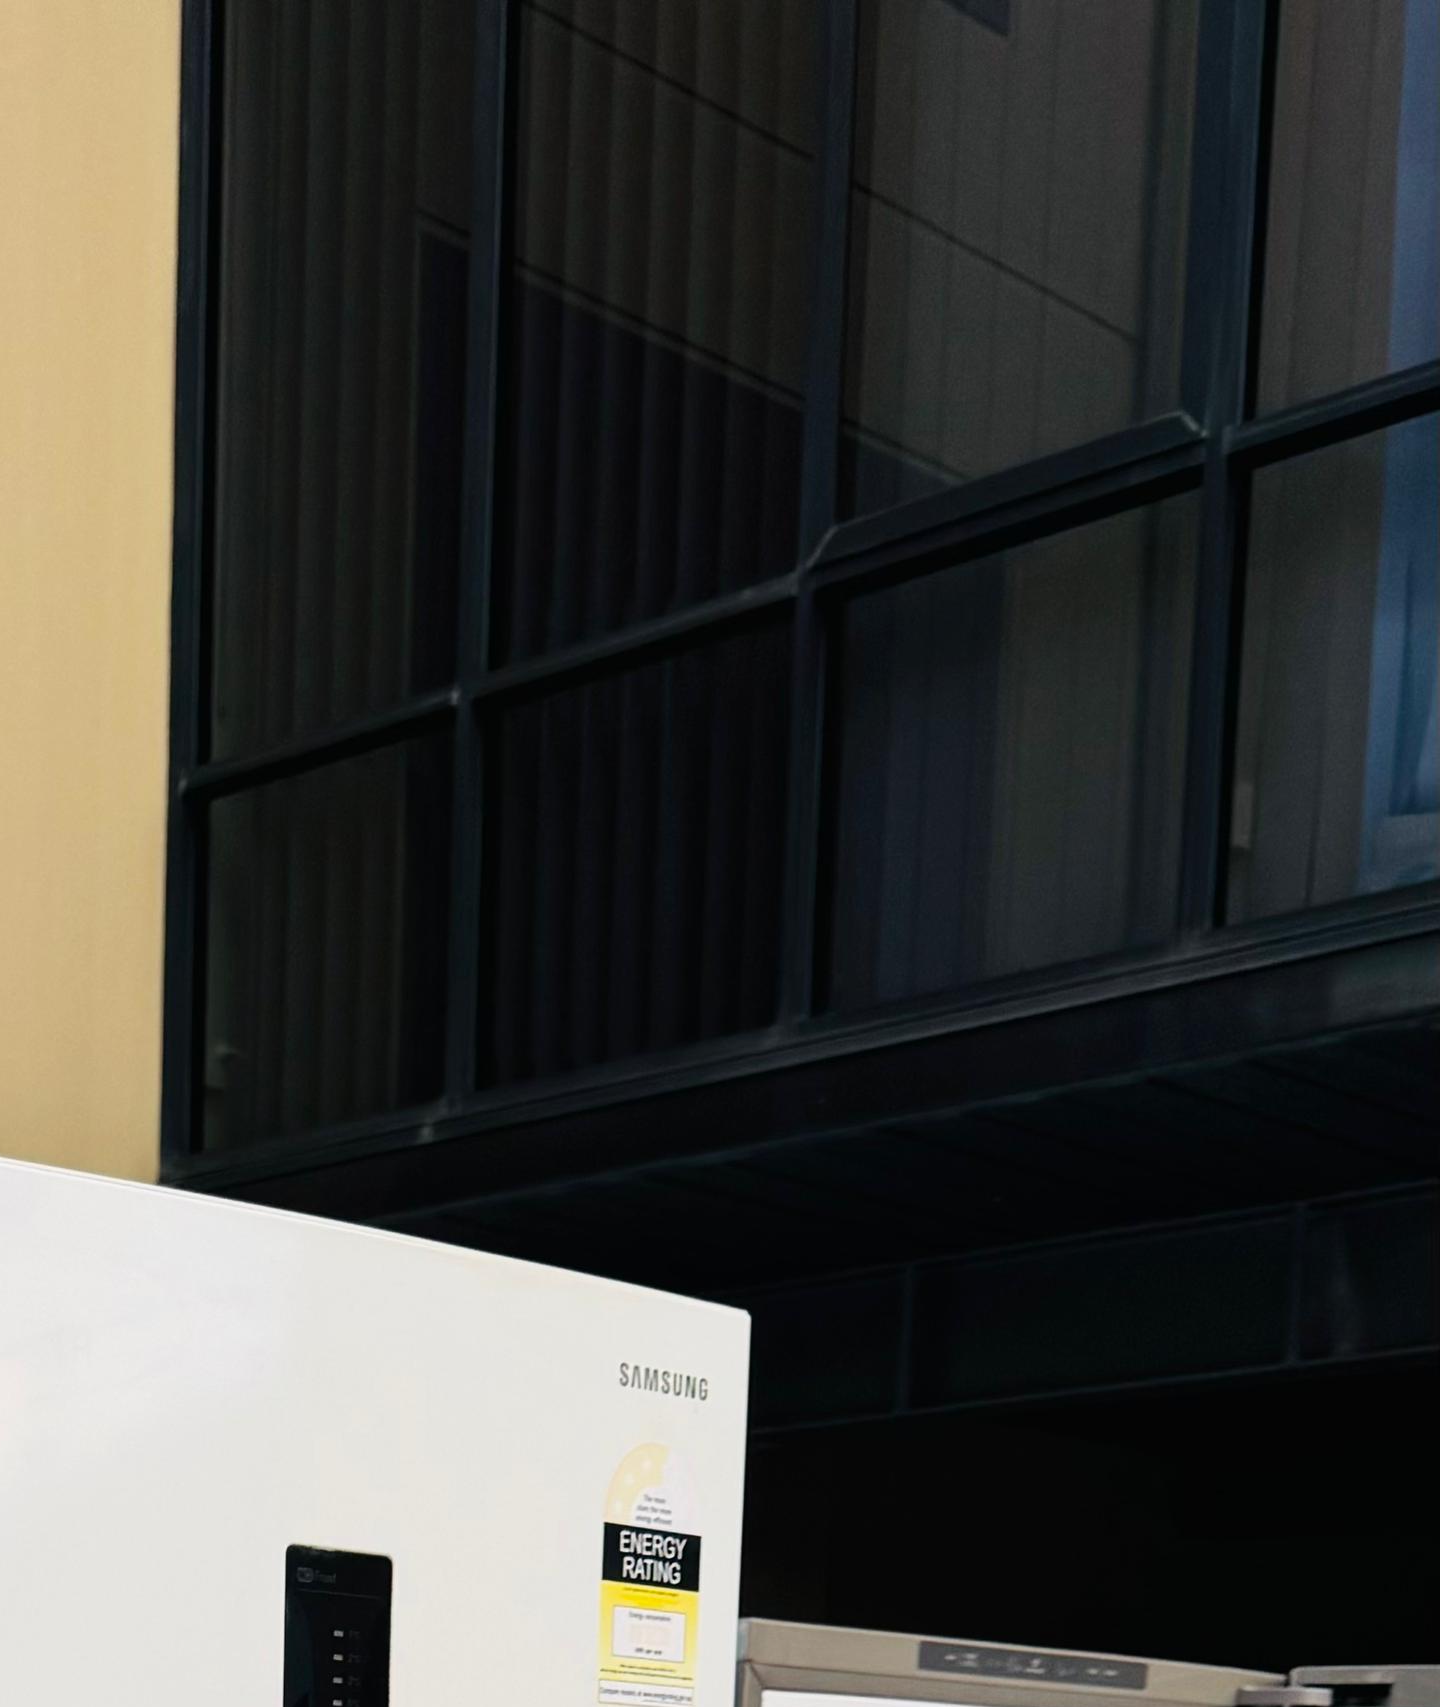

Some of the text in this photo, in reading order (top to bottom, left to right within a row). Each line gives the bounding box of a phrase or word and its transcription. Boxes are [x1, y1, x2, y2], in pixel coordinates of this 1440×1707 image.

[619, 1362, 709, 1401] SAMSUNG
[619, 1529, 687, 1560] ENERGY
[622, 1556, 681, 1585] RATING
